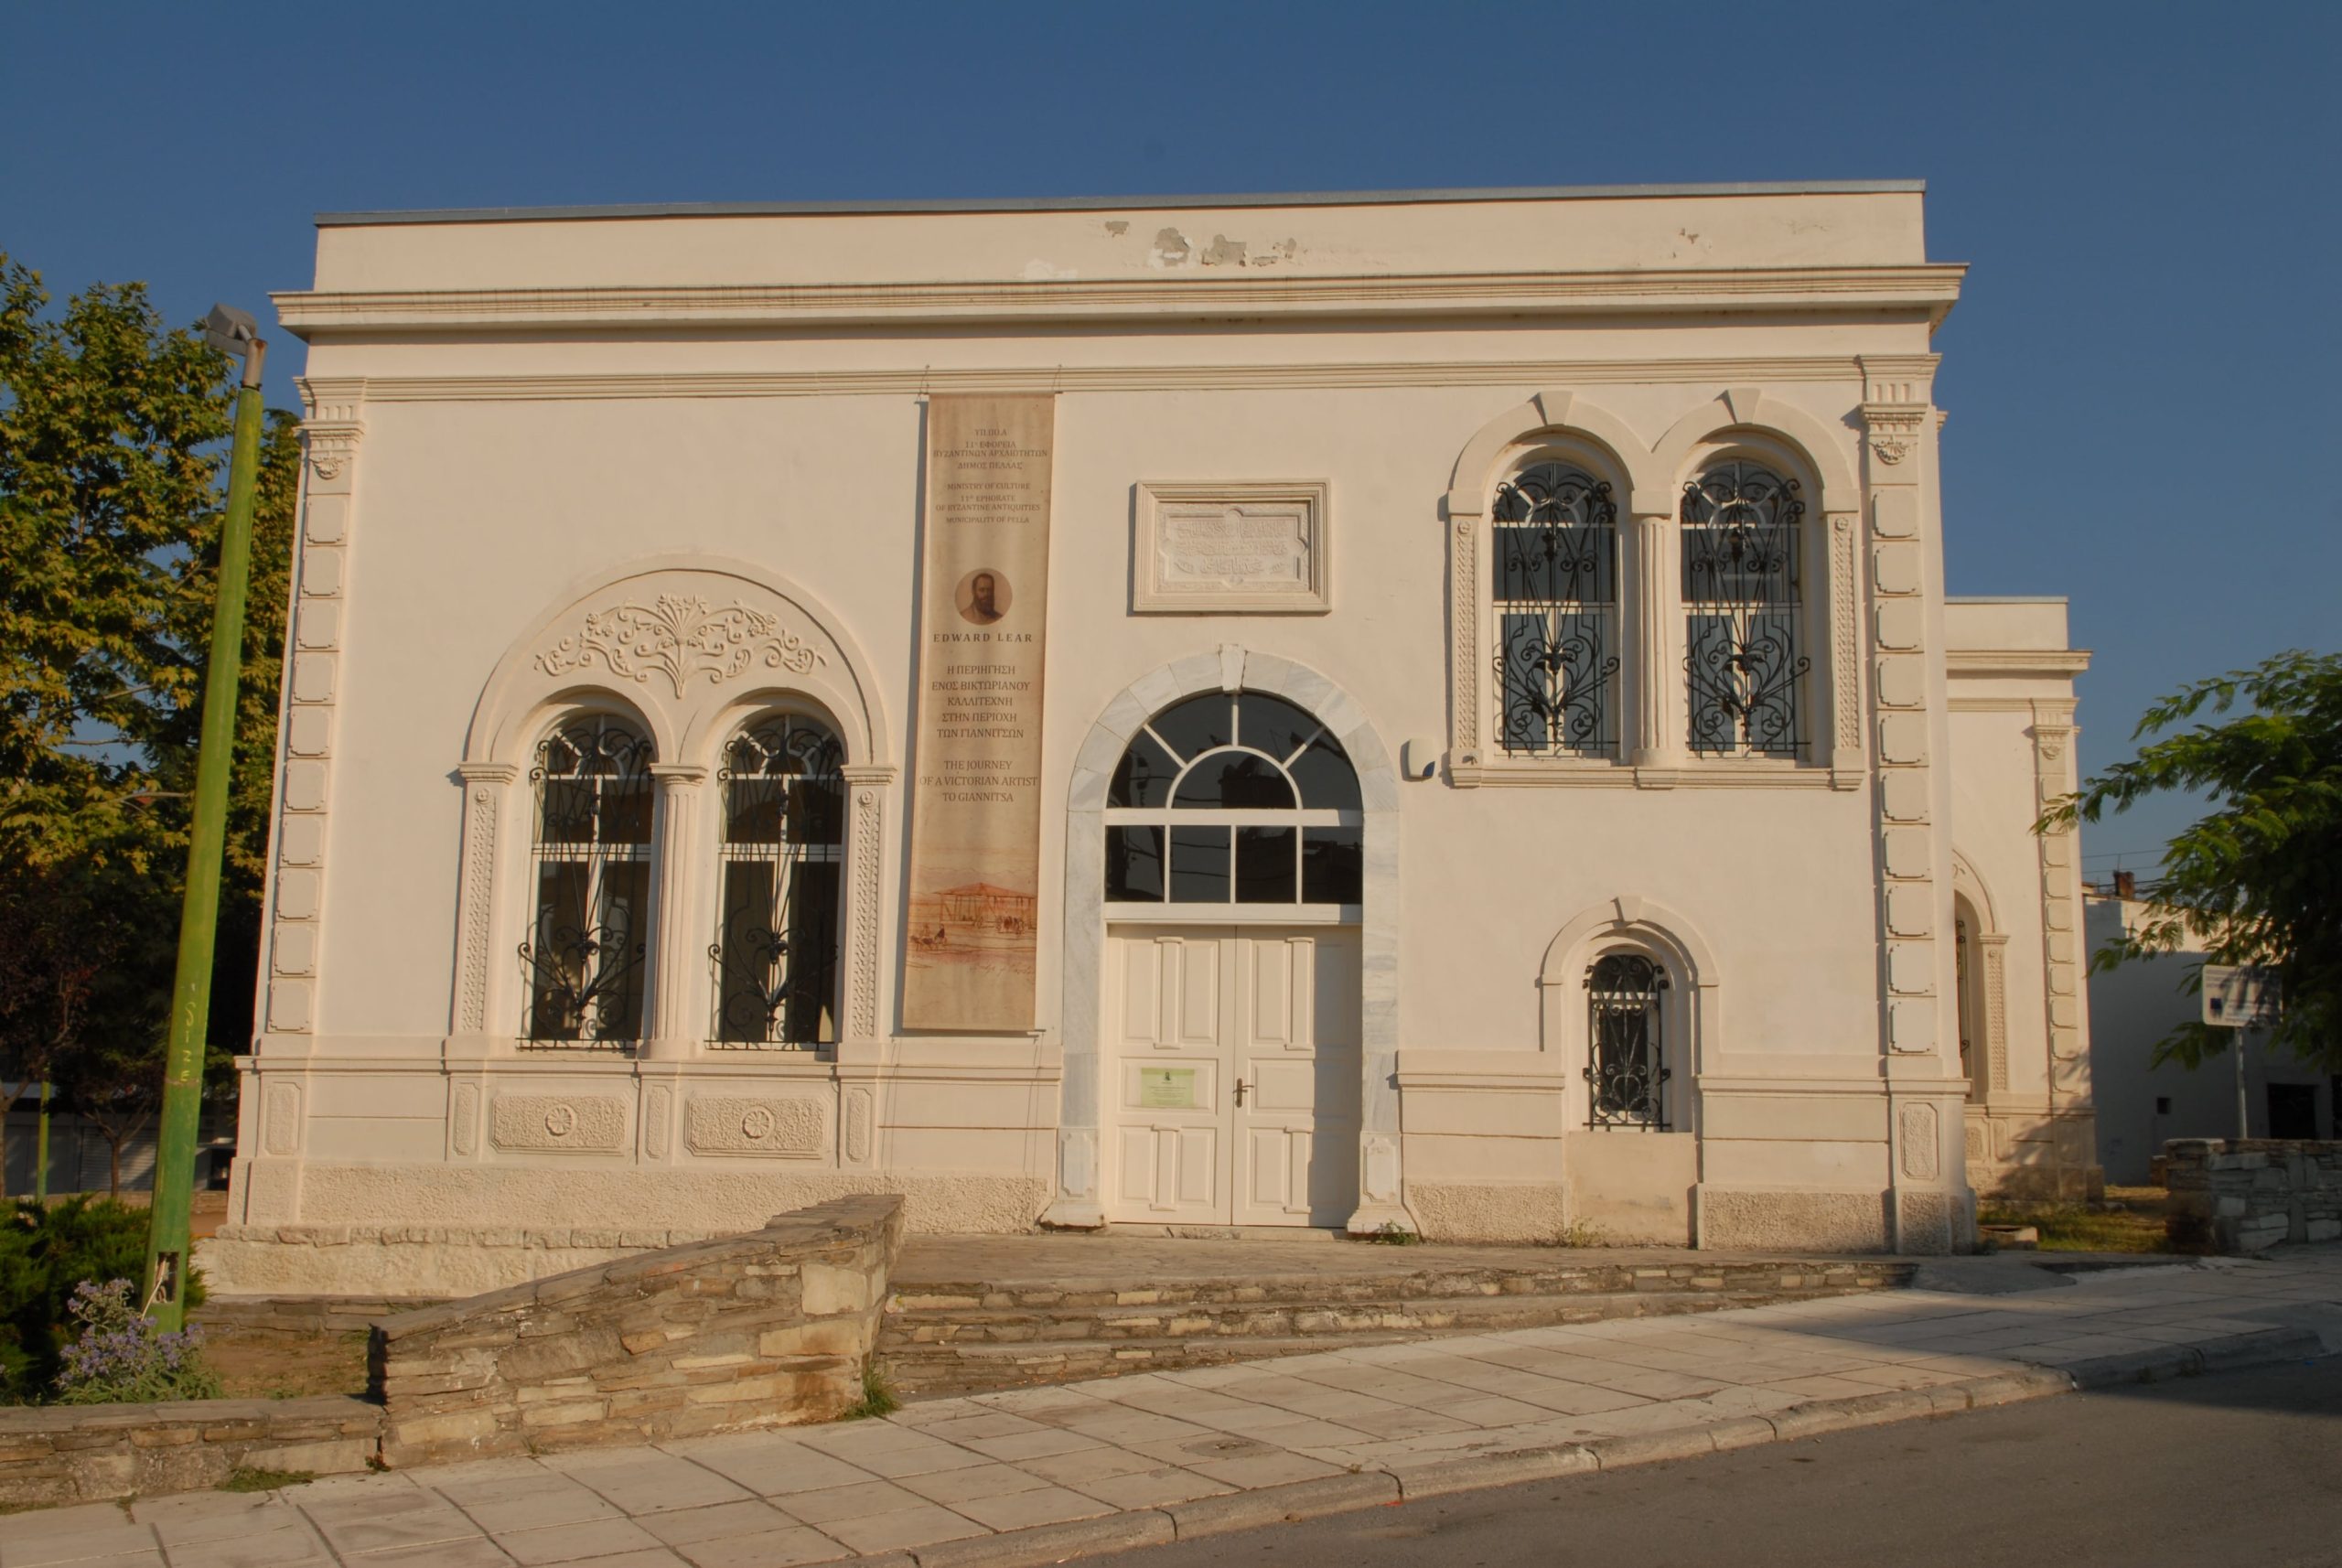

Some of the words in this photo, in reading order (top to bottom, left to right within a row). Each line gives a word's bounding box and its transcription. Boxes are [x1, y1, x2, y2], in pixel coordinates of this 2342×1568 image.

[933, 634, 990, 642] EDWARD
[997, 634, 1032, 642] LEAR
[947, 666, 954, 674] Η
[957, 666, 1015, 674] ΠΕΡΙΗΓΗΣΗ
[932, 682, 958, 691] ΕΝΟΣ
[962, 682, 1030, 691] ΒΙΚΤΩΡΙΑΝΟΥ
[948, 697, 1013, 706] ΚΑΛΛΙΤΕΧΝΗ
[942, 713, 969, 722] ΣΤΗΝ
[972, 713, 1016, 722] ΠΕΡΙΟΧΗ
[937, 729, 958, 737] ΤΩΝ
[961, 729, 1024, 738] ΓΙΑΝΝΙΤΣΩΝ
[944, 760, 964, 769] THE
[967, 760, 1013, 770] JOURNEY
[920, 776, 934, 785] OF
[936, 777, 942, 785] A
[944, 776, 1000, 786] VICTORIAN
[1002, 777, 1037, 786] ARTIST
[943, 792, 956, 801] TO
[959, 792, 1014, 801] GIANNITSA
